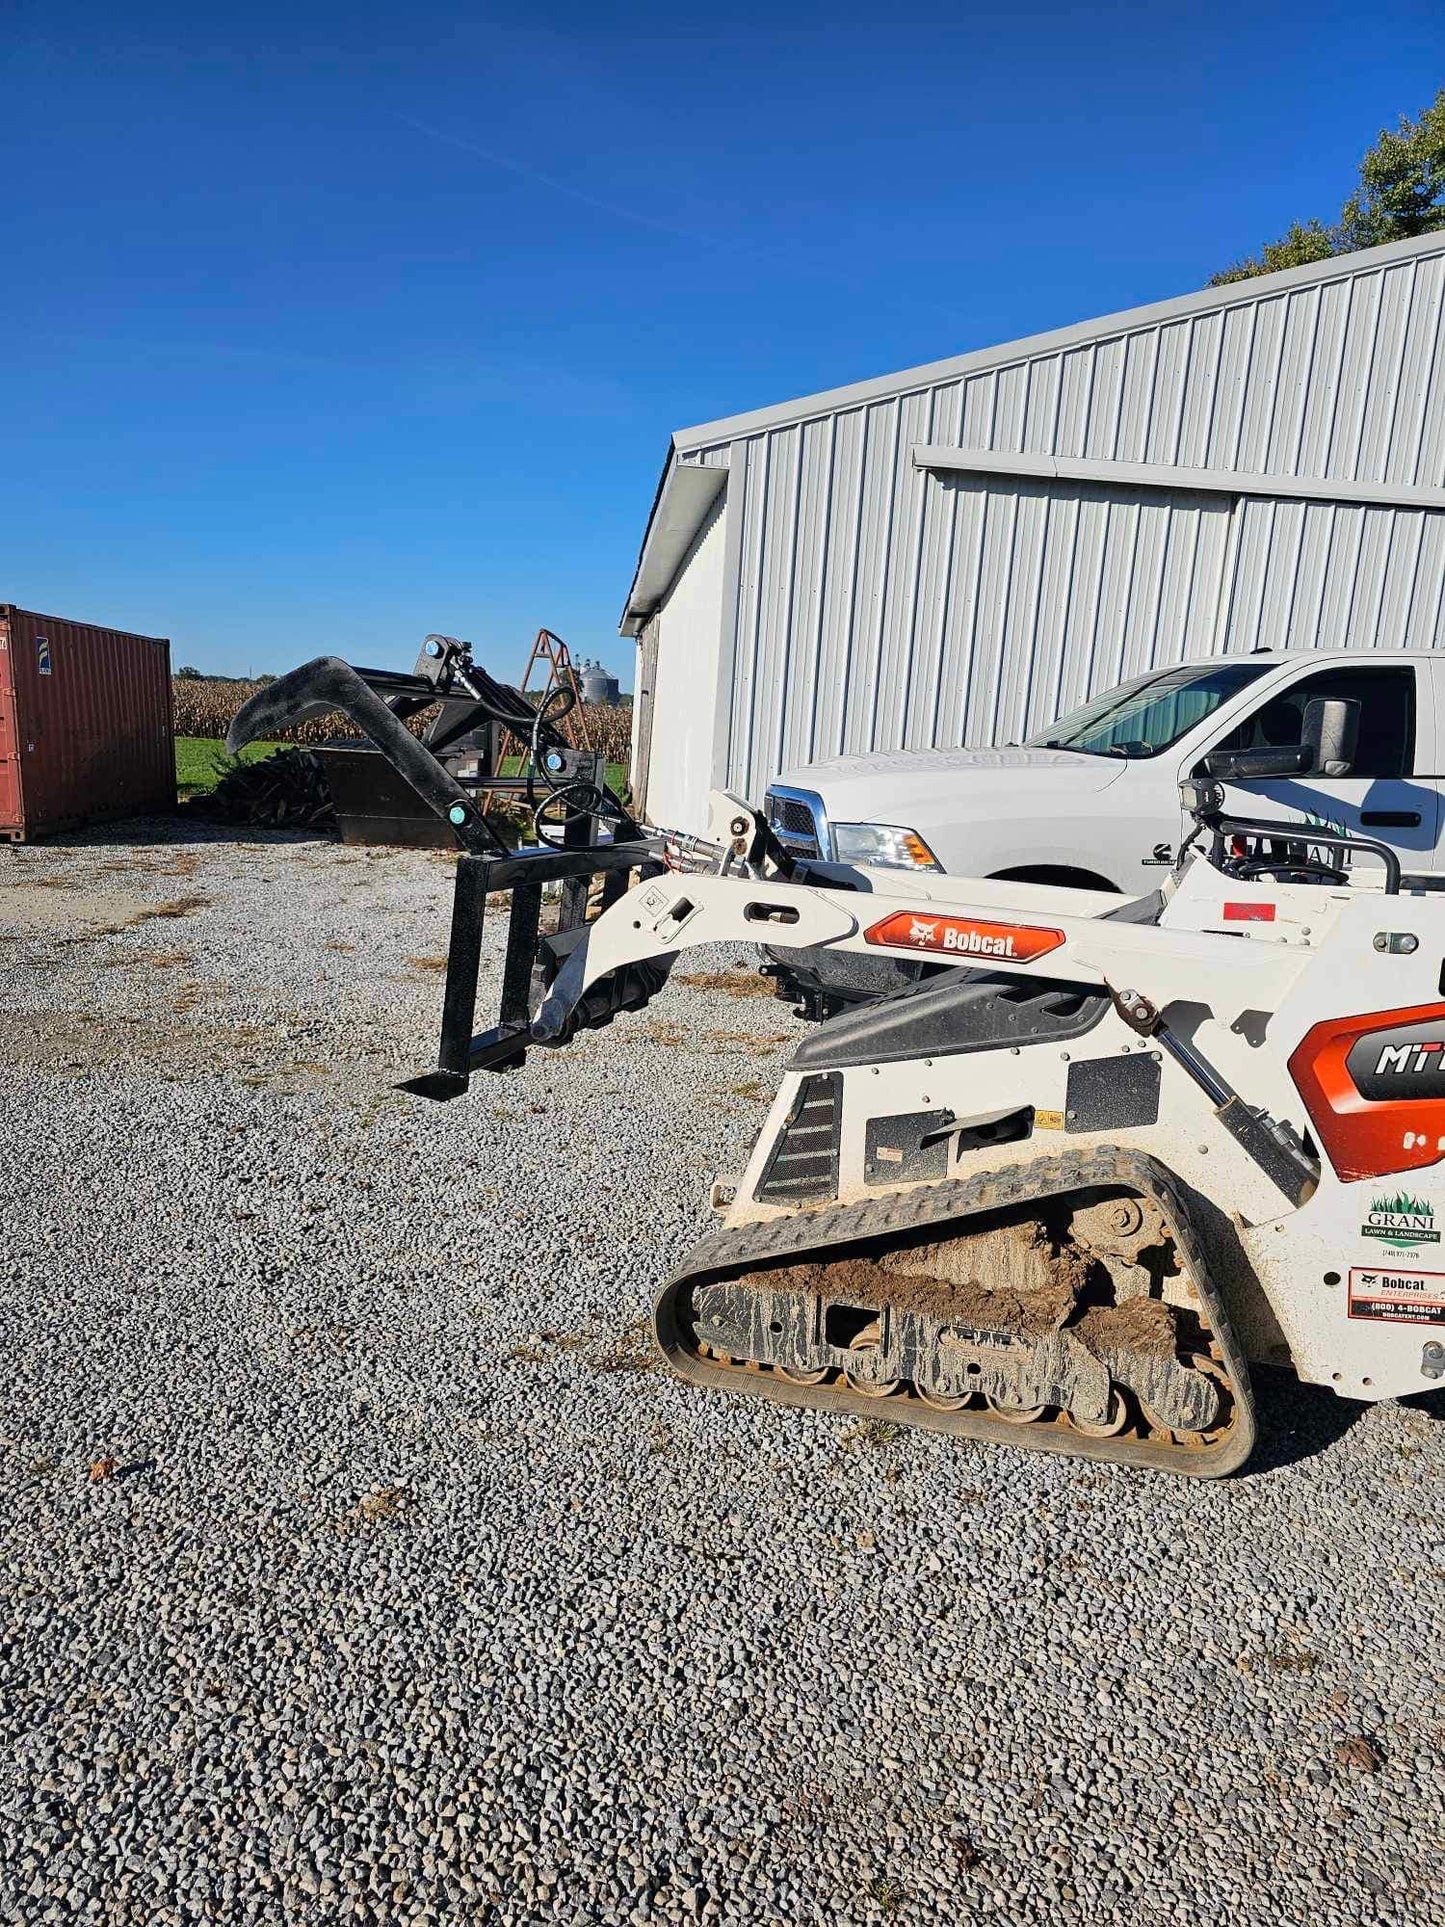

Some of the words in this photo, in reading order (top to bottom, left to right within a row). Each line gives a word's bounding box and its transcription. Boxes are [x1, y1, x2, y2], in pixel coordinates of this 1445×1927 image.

[943, 928, 1014, 957] Bobcat
[1368, 1213, 1435, 1229] GRANI
[1364, 1228, 1386, 1236] LAWN
[1394, 1230, 1438, 1240] LANDSCAPE
[1382, 1276, 1424, 1290] Bobcat
[1381, 1290, 1439, 1300] ENTERPRISES
[1371, 1302, 1395, 1312] (800)
[1397, 1304, 1442, 1314] 4-BOBCAT
